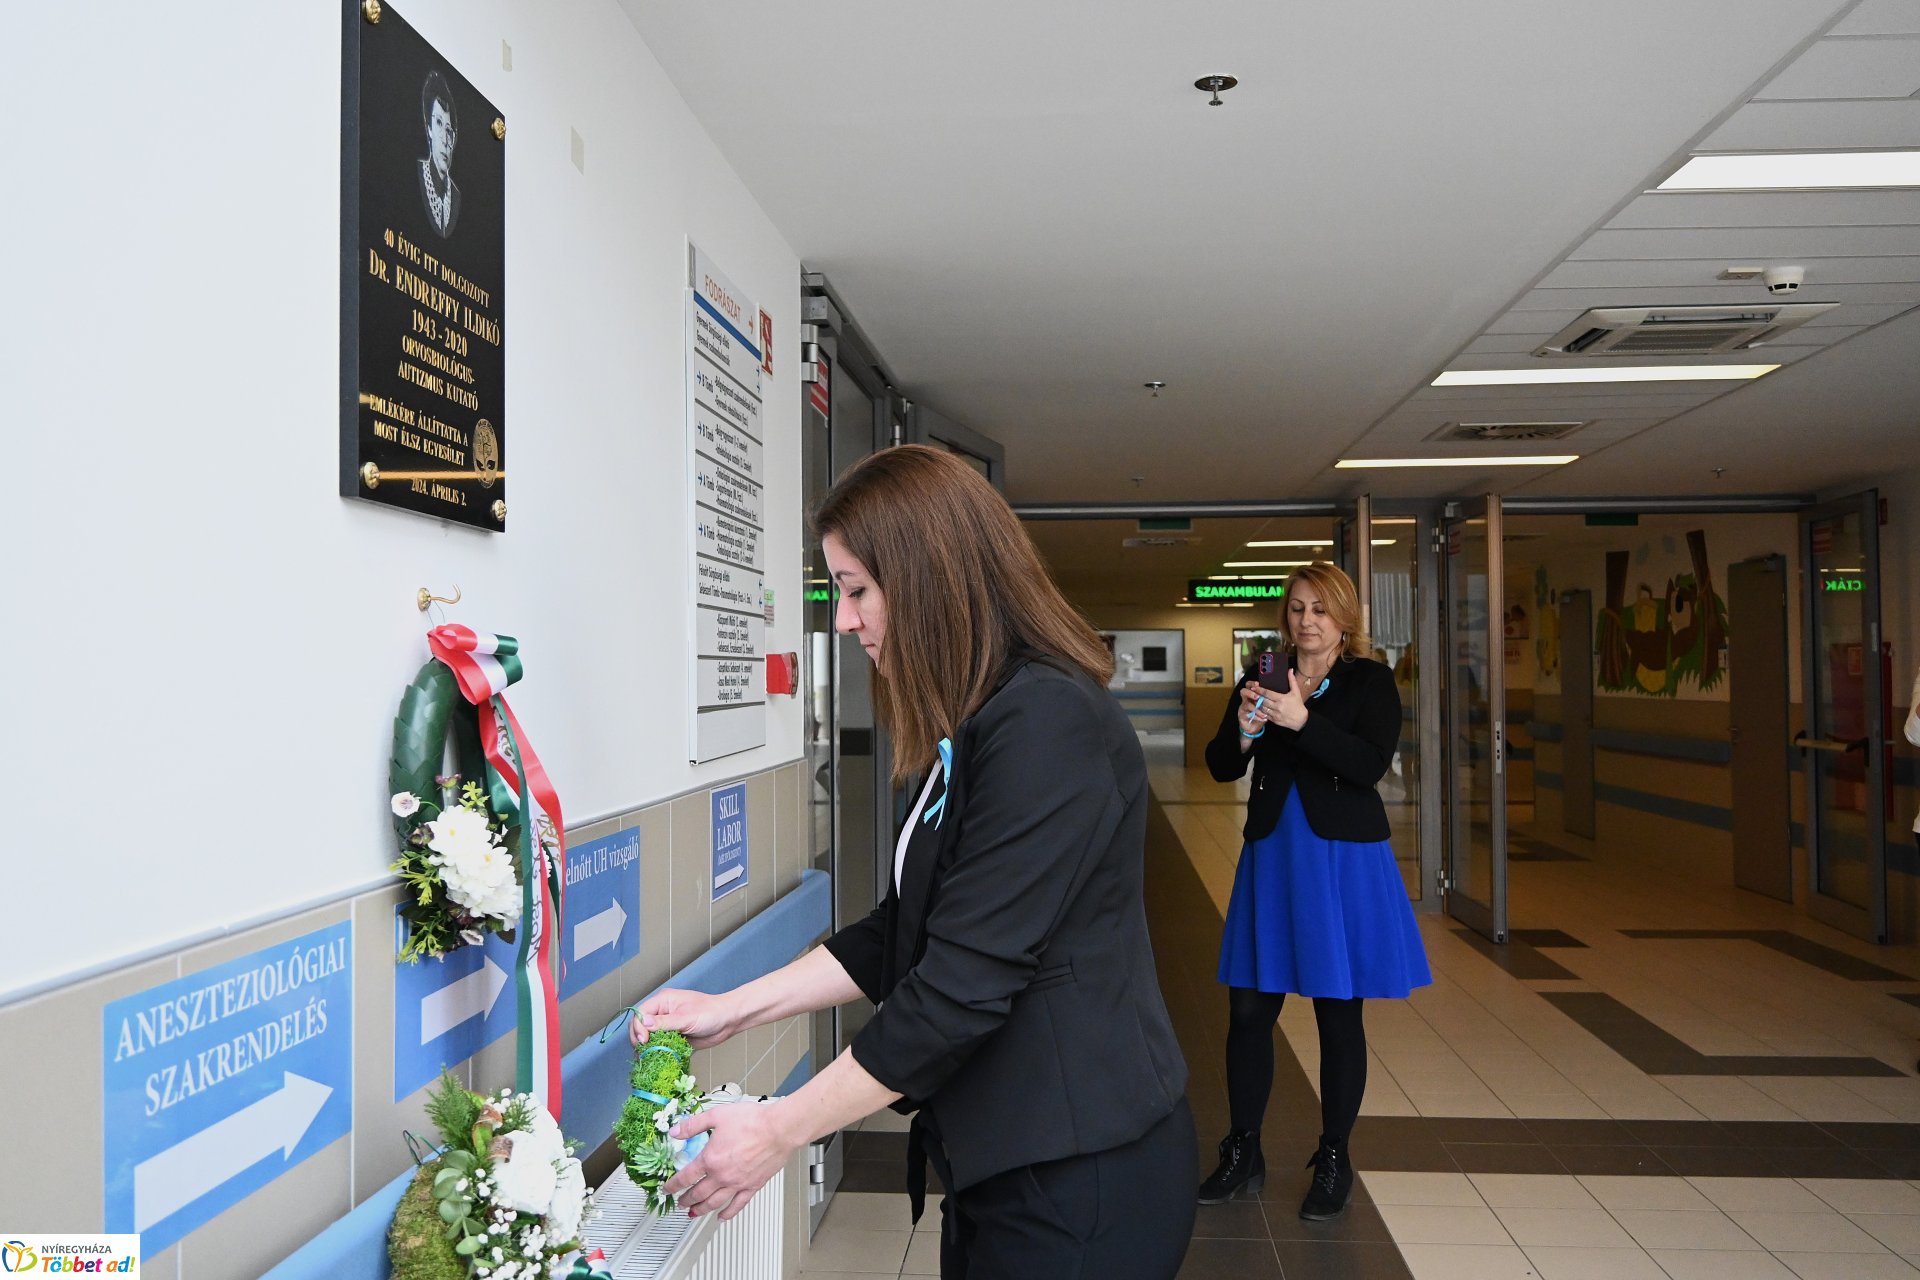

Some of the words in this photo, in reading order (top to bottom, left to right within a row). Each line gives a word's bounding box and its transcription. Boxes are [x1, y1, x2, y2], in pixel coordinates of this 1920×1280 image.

[384, 228, 394, 248] 40
[398, 232, 421, 265] ÉVIG
[424, 252, 438, 276] ITT
[441, 264, 490, 308] DOLGOZOTT
[369, 248, 390, 284] DR.
[396, 264, 460, 323] ENDREFFY
[463, 305, 500, 347] ILDIKÓ
[705, 274, 742, 323] FODRÁSZAT
[412, 309, 436, 341] 1943
[444, 327, 467, 358] 2020
[402, 335, 475, 385] ORVOSBIOLÓGUS-
[398, 360, 444, 396] AUTIZMUS
[446, 382, 479, 411] KUTATÓ
[369, 394, 415, 426] EMLÉKÉRE
[418, 410, 462, 446] ÁLLÍTTATTA
[463, 432, 468, 447] A
[374, 420, 398, 443] MOST
[401, 426, 421, 451] ÉLSZ
[423, 438, 465, 467] EGYESÜLET
[411, 477, 428, 495] 2024.
[431, 479, 459, 505] ÁPRILIS
[461, 491, 467, 506] 2.
[1195, 586, 1285, 598] SZAKAMBULAN
[719, 793, 740, 821] SKILL
[566, 854, 592, 886] elnőtt
[594, 846, 608, 875] UH
[609, 835, 639, 871] vizsgáló
[717, 821, 742, 851] LABOR
[113, 937, 346, 1062] ANESZTEZIOLÓGIAI
[144, 996, 328, 1117] SZAKRENDELÉS
